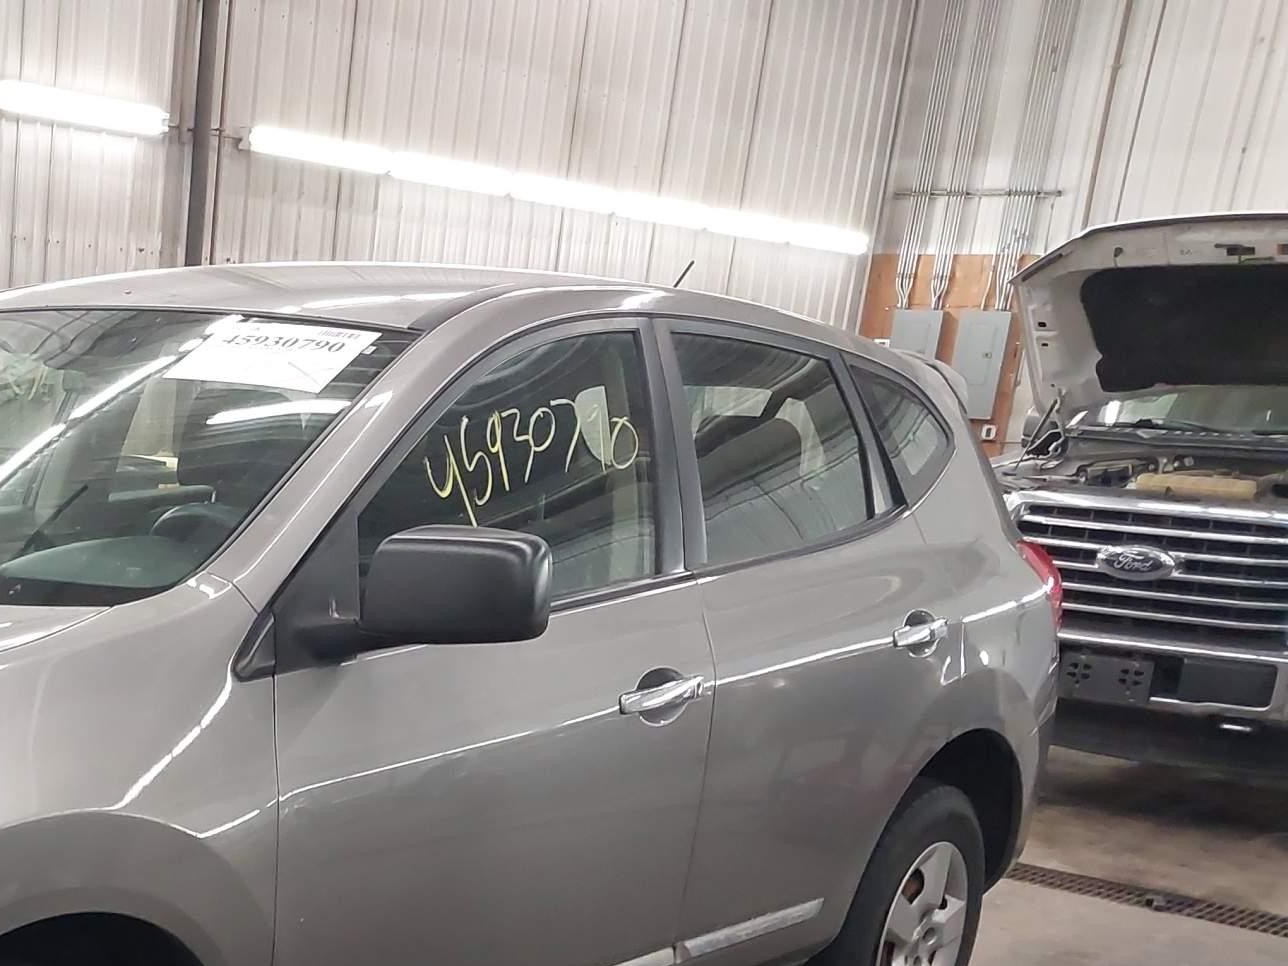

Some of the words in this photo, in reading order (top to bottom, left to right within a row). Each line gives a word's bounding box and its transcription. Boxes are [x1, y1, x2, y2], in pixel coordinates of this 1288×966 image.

[223, 334, 346, 353] 45930790
[424, 398, 639, 528] 45930790
[1113, 552, 1153, 572] Ford
